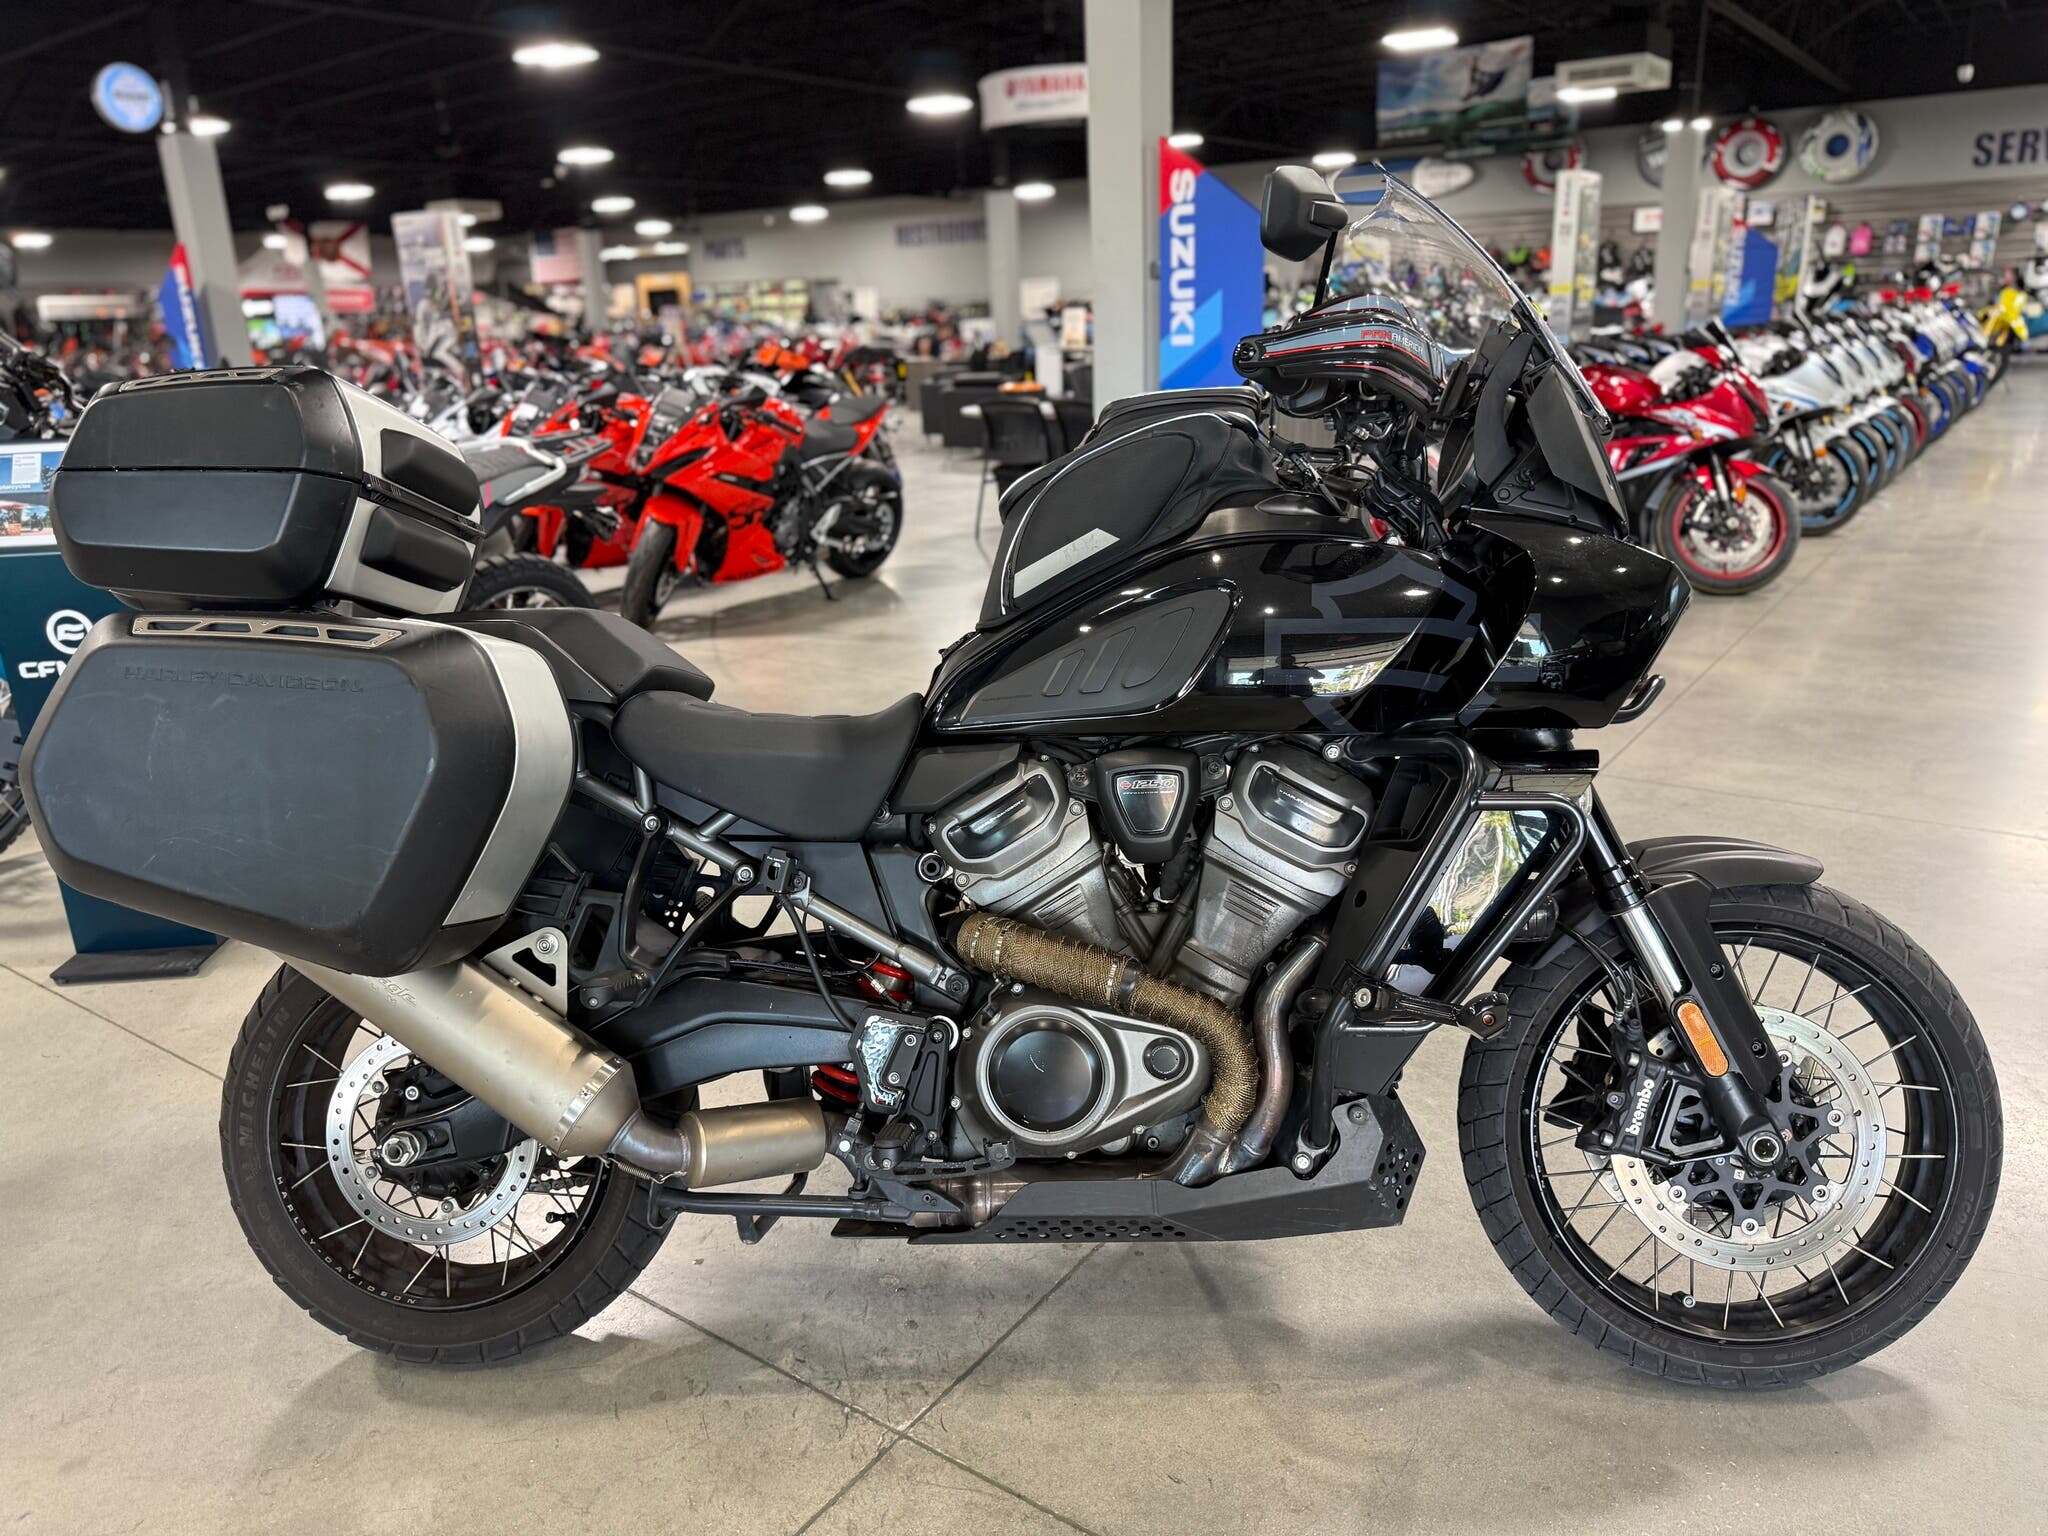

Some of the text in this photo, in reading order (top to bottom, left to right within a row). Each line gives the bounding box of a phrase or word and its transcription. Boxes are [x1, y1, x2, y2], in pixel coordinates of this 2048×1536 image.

[1972, 130, 2048, 168] SER
[1169, 168, 1197, 347] SUZUKI
[238, 1007, 291, 1147] MICHELIN
[1624, 1079, 1655, 1136] brembo
